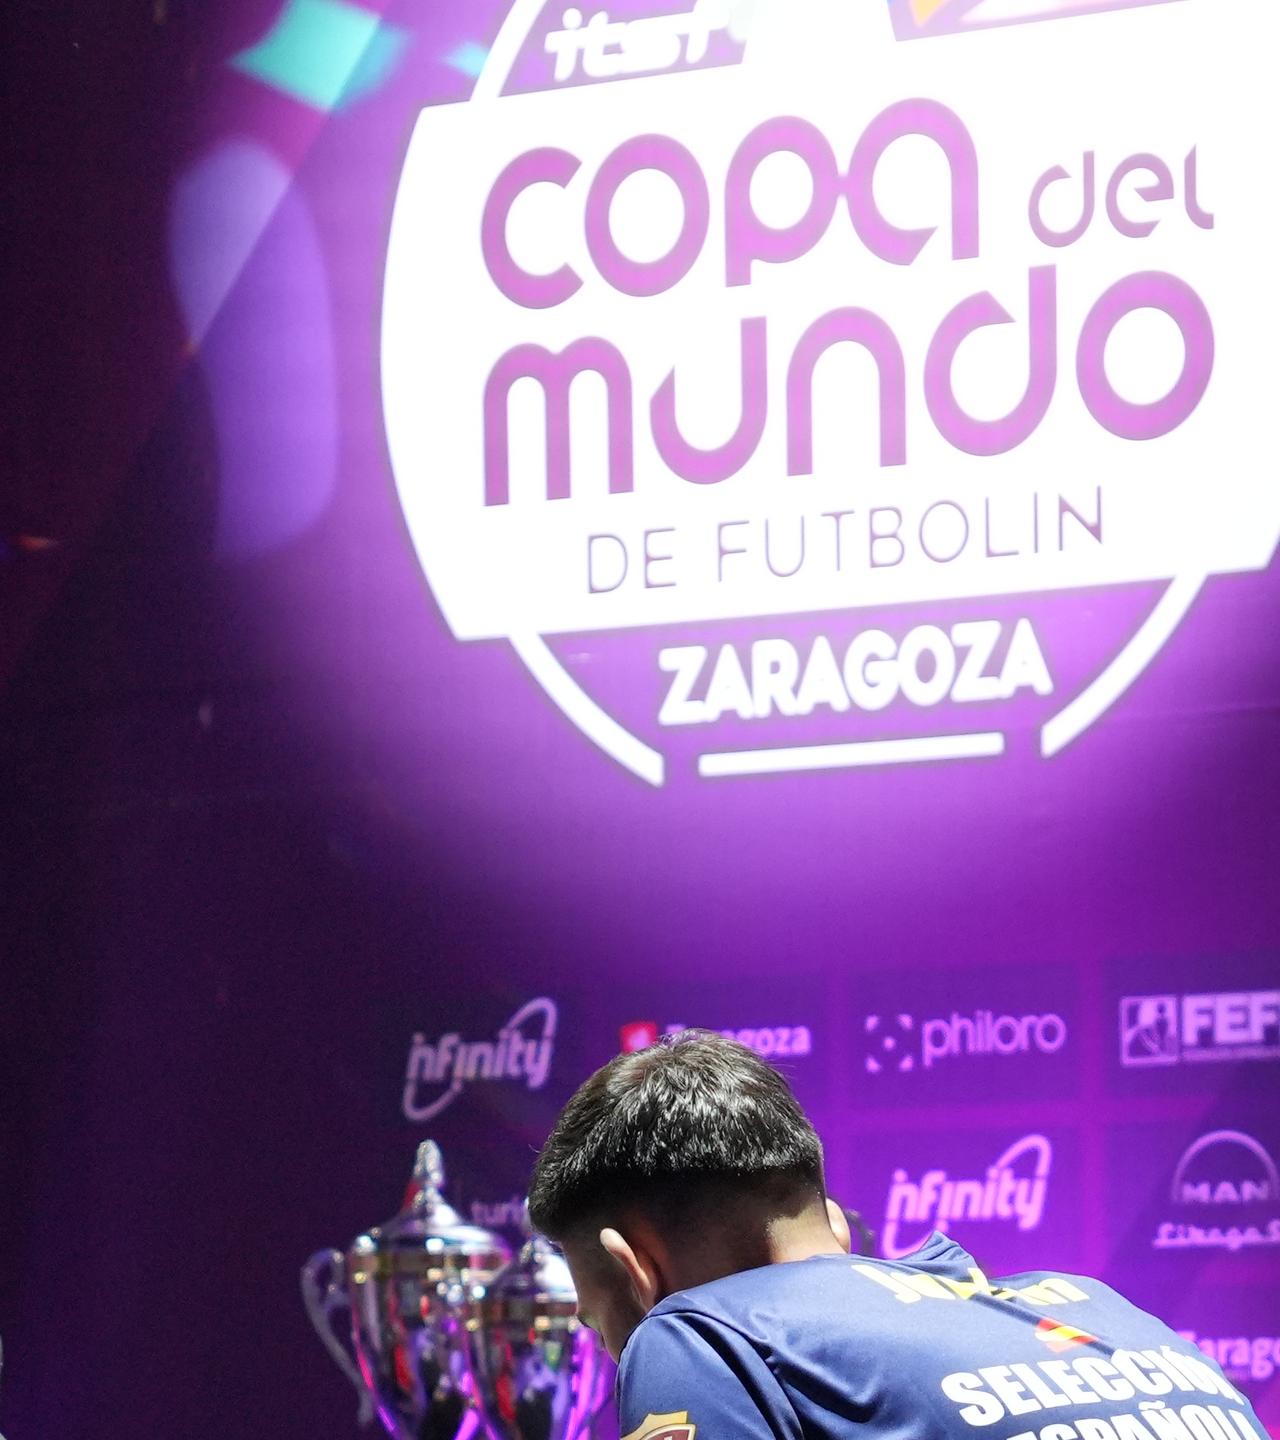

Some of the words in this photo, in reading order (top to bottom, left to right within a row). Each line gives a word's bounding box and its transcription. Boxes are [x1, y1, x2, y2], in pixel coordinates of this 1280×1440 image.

[1027, 143, 1215, 249] del
[586, 527, 677, 594] DE
[715, 485, 1105, 583] FUTBOLIN
[657, 618, 1053, 727] ZARAGOZA
[923, 1010, 1066, 1068] philoro
[1181, 1180, 1269, 1204] MAN
